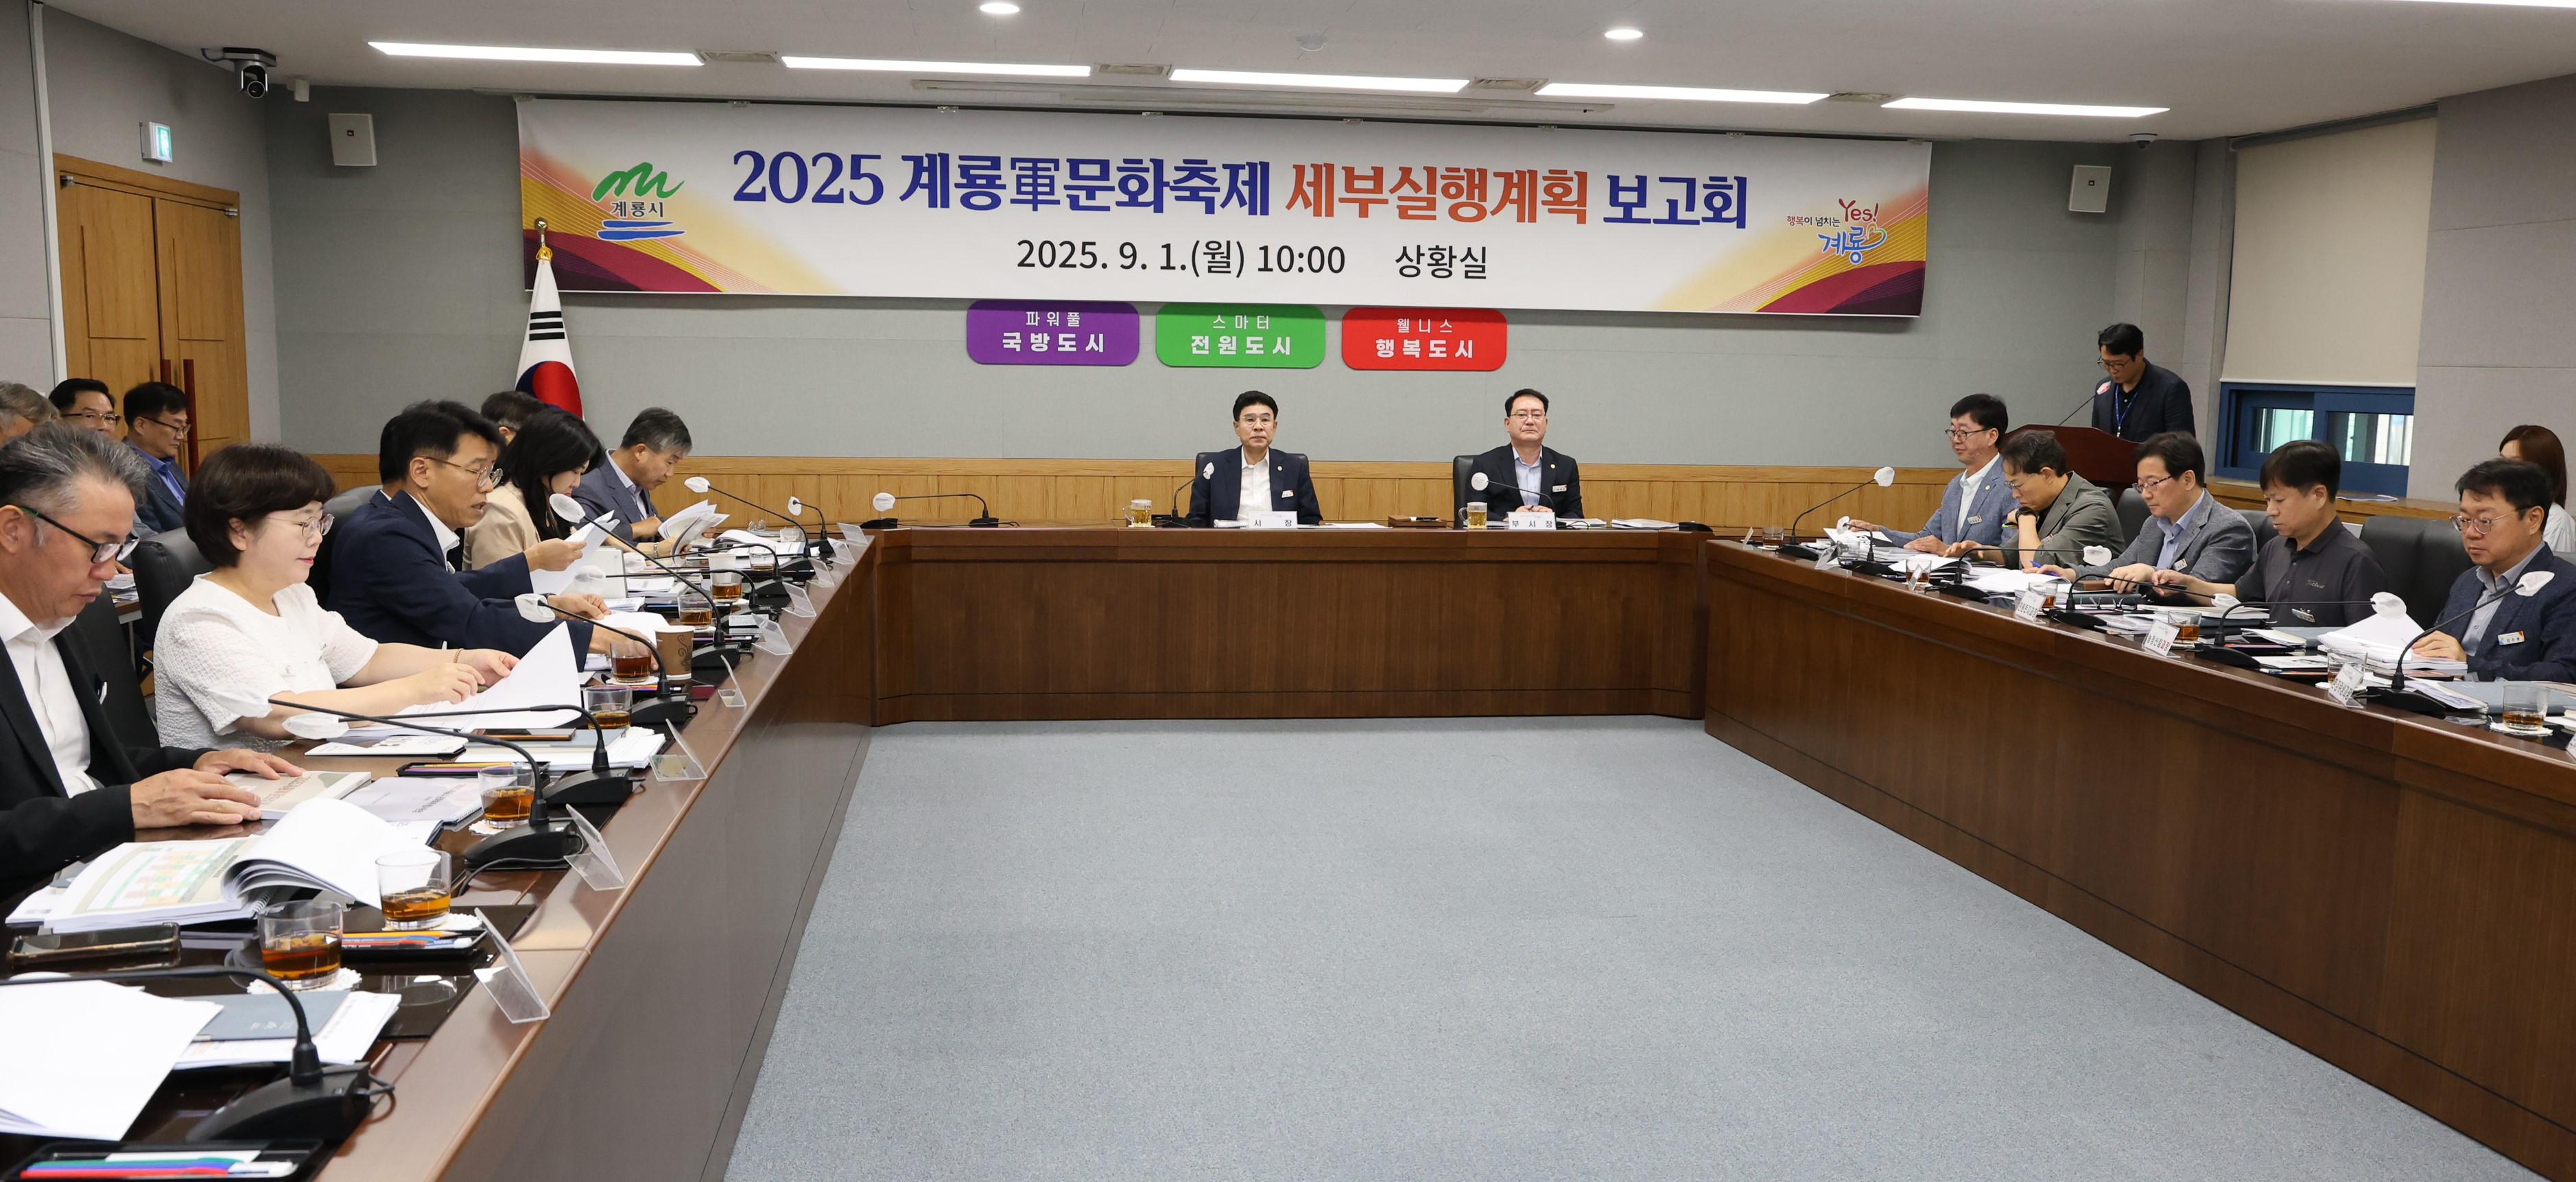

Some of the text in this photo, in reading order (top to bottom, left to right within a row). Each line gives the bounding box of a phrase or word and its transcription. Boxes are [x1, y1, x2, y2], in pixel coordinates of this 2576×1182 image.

[734, 150, 1747, 229] 2025 계룡軍문화축제 세부실행계획 보고회
[611, 201, 664, 217] 계룡시
[1838, 198, 1879, 222] Yes!
[1786, 215, 1841, 227] 행복이 넘치는
[1817, 226, 1870, 264] 계룡
[1017, 239, 1487, 279] 2025. 9. 1.(월) 10:00 상황실
[1026, 311, 1080, 327] 파워풀
[1212, 315, 1270, 330] 스마터
[1396, 318, 1453, 333] 웰니스
[1002, 332, 1104, 353] 국방도시
[1190, 335, 1291, 355] 전원도시
[1375, 339, 1474, 358] 행복도시
